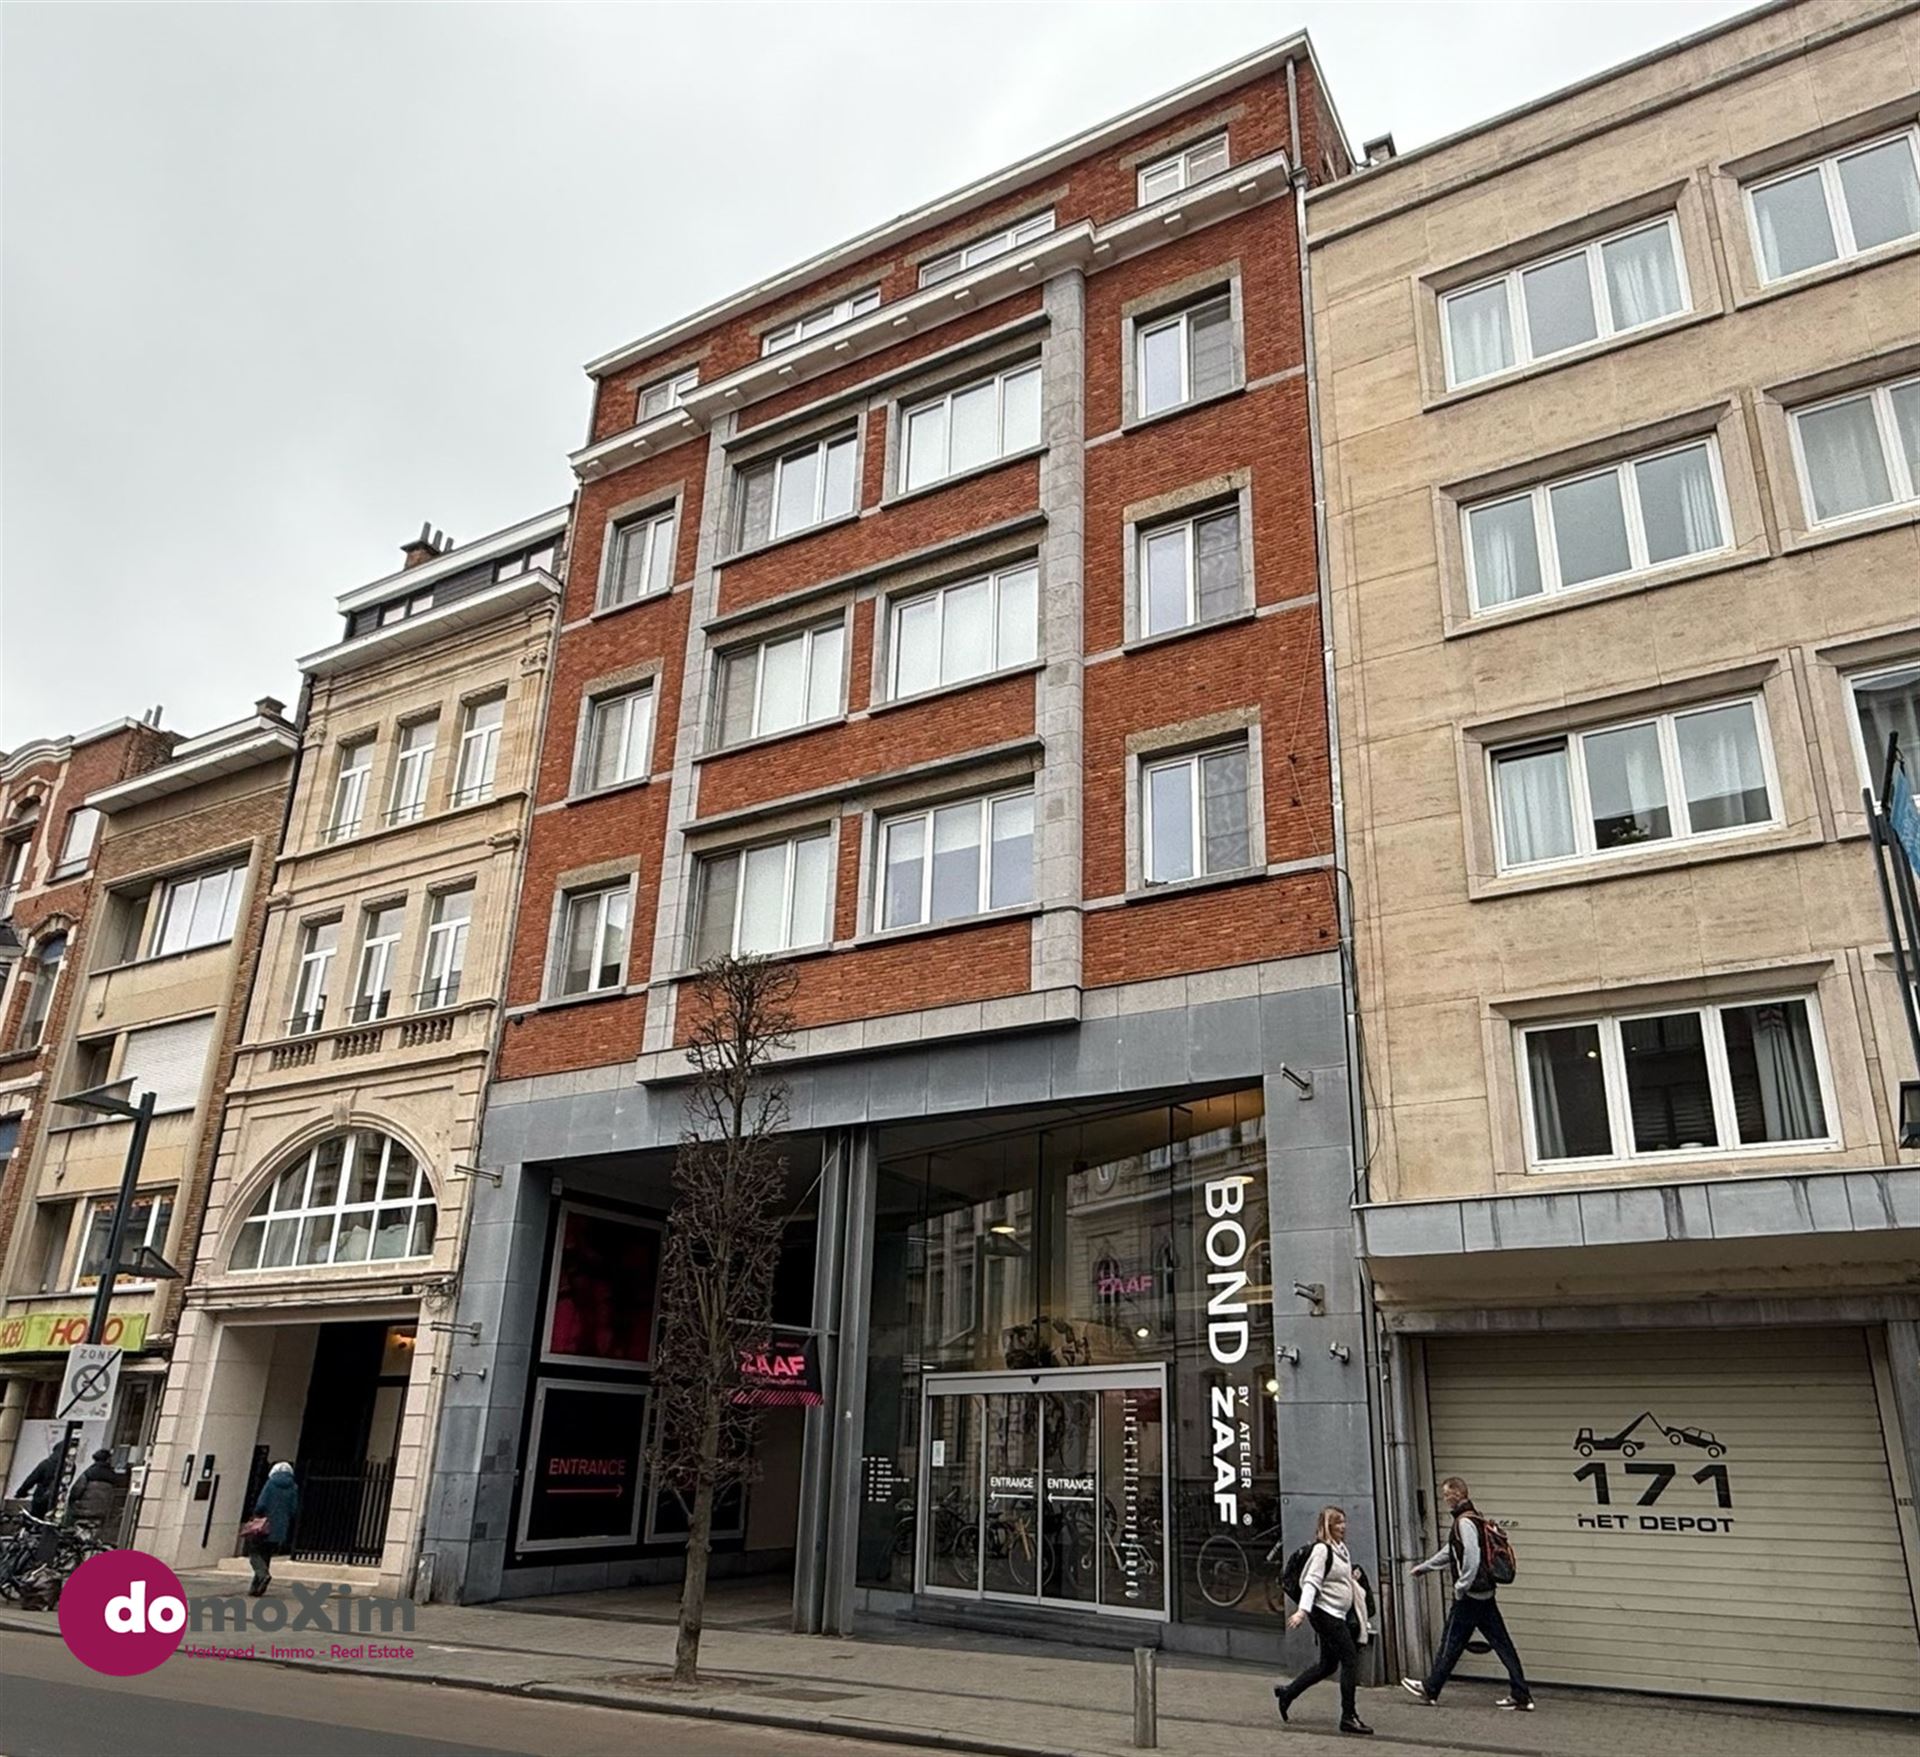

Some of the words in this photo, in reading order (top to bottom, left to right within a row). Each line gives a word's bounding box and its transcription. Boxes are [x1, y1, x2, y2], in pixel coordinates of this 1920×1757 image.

[1205, 1180, 1249, 1364] BOND
[48, 1317, 124, 1345] HOO
[79, 1349, 114, 1360] ZONE
[1238, 1385, 1249, 1407] BY
[1239, 1421, 1252, 1489] ATELIER
[548, 1457, 627, 1476] ENTRANCE
[990, 1476, 1034, 1488] ENTRANCE
[1047, 1478, 1094, 1490] ENTRANCE
[1573, 1462, 1732, 1509] 171
[1639, 1515, 1735, 1533] DEPOT
